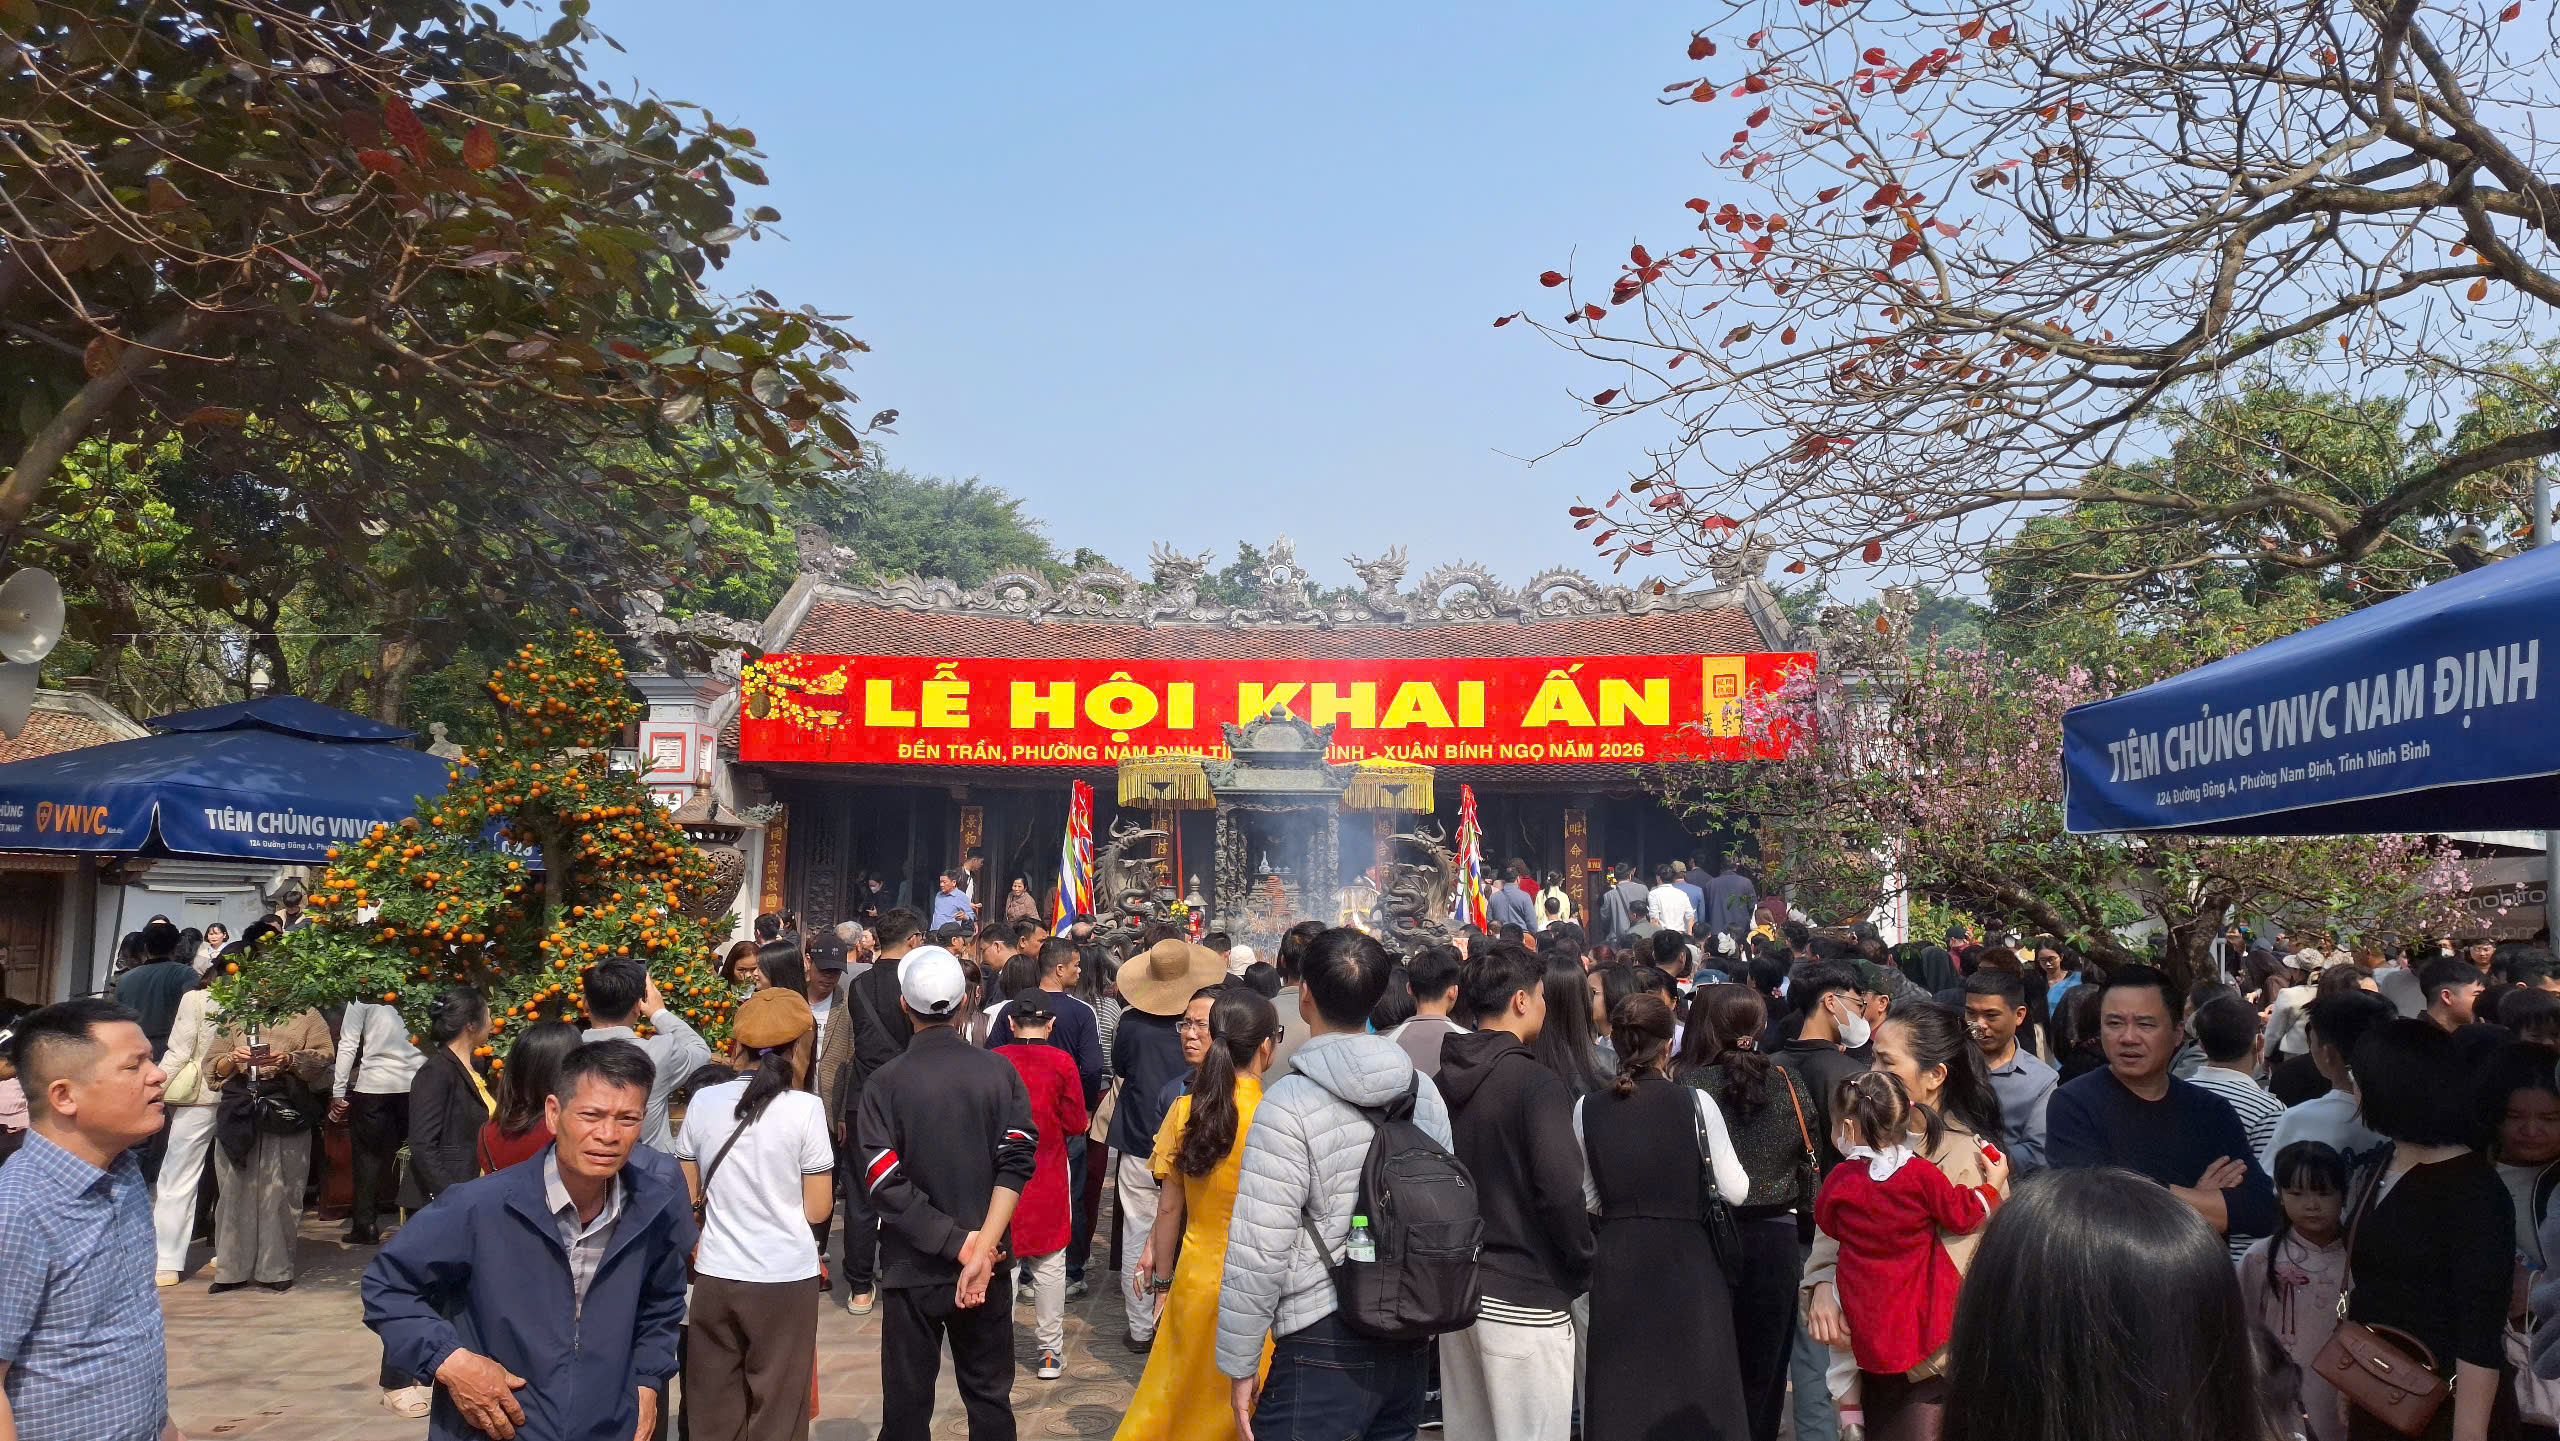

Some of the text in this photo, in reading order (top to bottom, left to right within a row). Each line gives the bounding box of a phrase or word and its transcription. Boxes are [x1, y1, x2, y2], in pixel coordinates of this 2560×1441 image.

[865, 661, 1670, 743] LỄ HỘI KHAI ẤN
[2107, 638, 2539, 783] TIÊM CHỦNG VNVC NAM ĐỊNH
[898, 740, 939, 759] ĐỀN
[947, 740, 1006, 762] TRẦN,
[1012, 742, 1098, 760] PHƯỜNG
[1104, 745, 1148, 760] NAM
[1384, 741, 1438, 759] XUÂN
[1445, 741, 1493, 759] BÍNH
[1499, 743, 1545, 762] NGỌ
[1550, 740, 1594, 758] NĂM
[1600, 742, 1646, 758] 2026
[2173, 786, 2201, 804] Đường
[2203, 780, 2226, 798] Đông
[2228, 777, 2238, 795] A,
[2240, 774, 2278, 791] Phường
[2280, 766, 2306, 784] Nam
[2308, 760, 2337, 782] Định,
[2338, 752, 2365, 773] Tỉnh
[2367, 747, 2397, 767] Ninh
[2400, 740, 2431, 762] Bình
[55, 803, 108, 835] VNVC
[204, 805, 253, 833] TIÊM
[257, 807, 325, 836] CHỦNG
